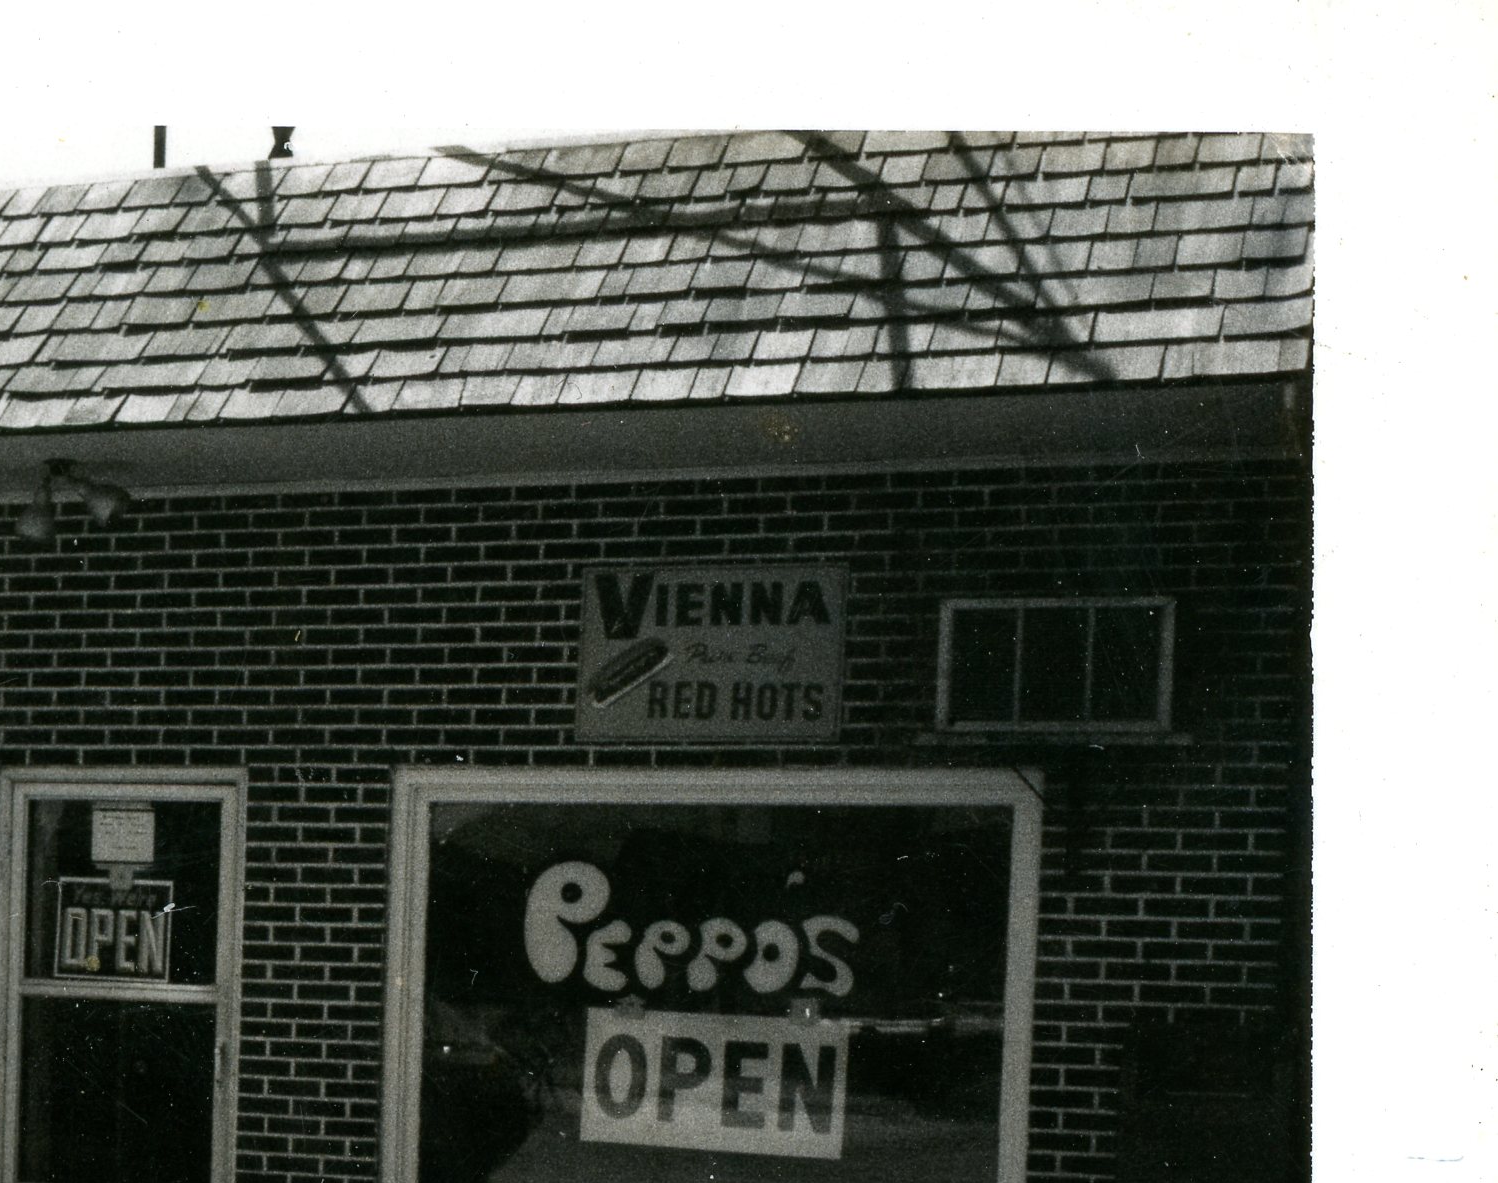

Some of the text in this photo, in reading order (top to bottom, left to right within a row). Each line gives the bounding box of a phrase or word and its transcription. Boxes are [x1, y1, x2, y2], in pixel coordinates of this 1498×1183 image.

[594, 573, 831, 640] VIENNA
[647, 681, 824, 721] RED HOTS
[61, 907, 166, 973] OPEN
[595, 1033, 837, 1135] OPEN
